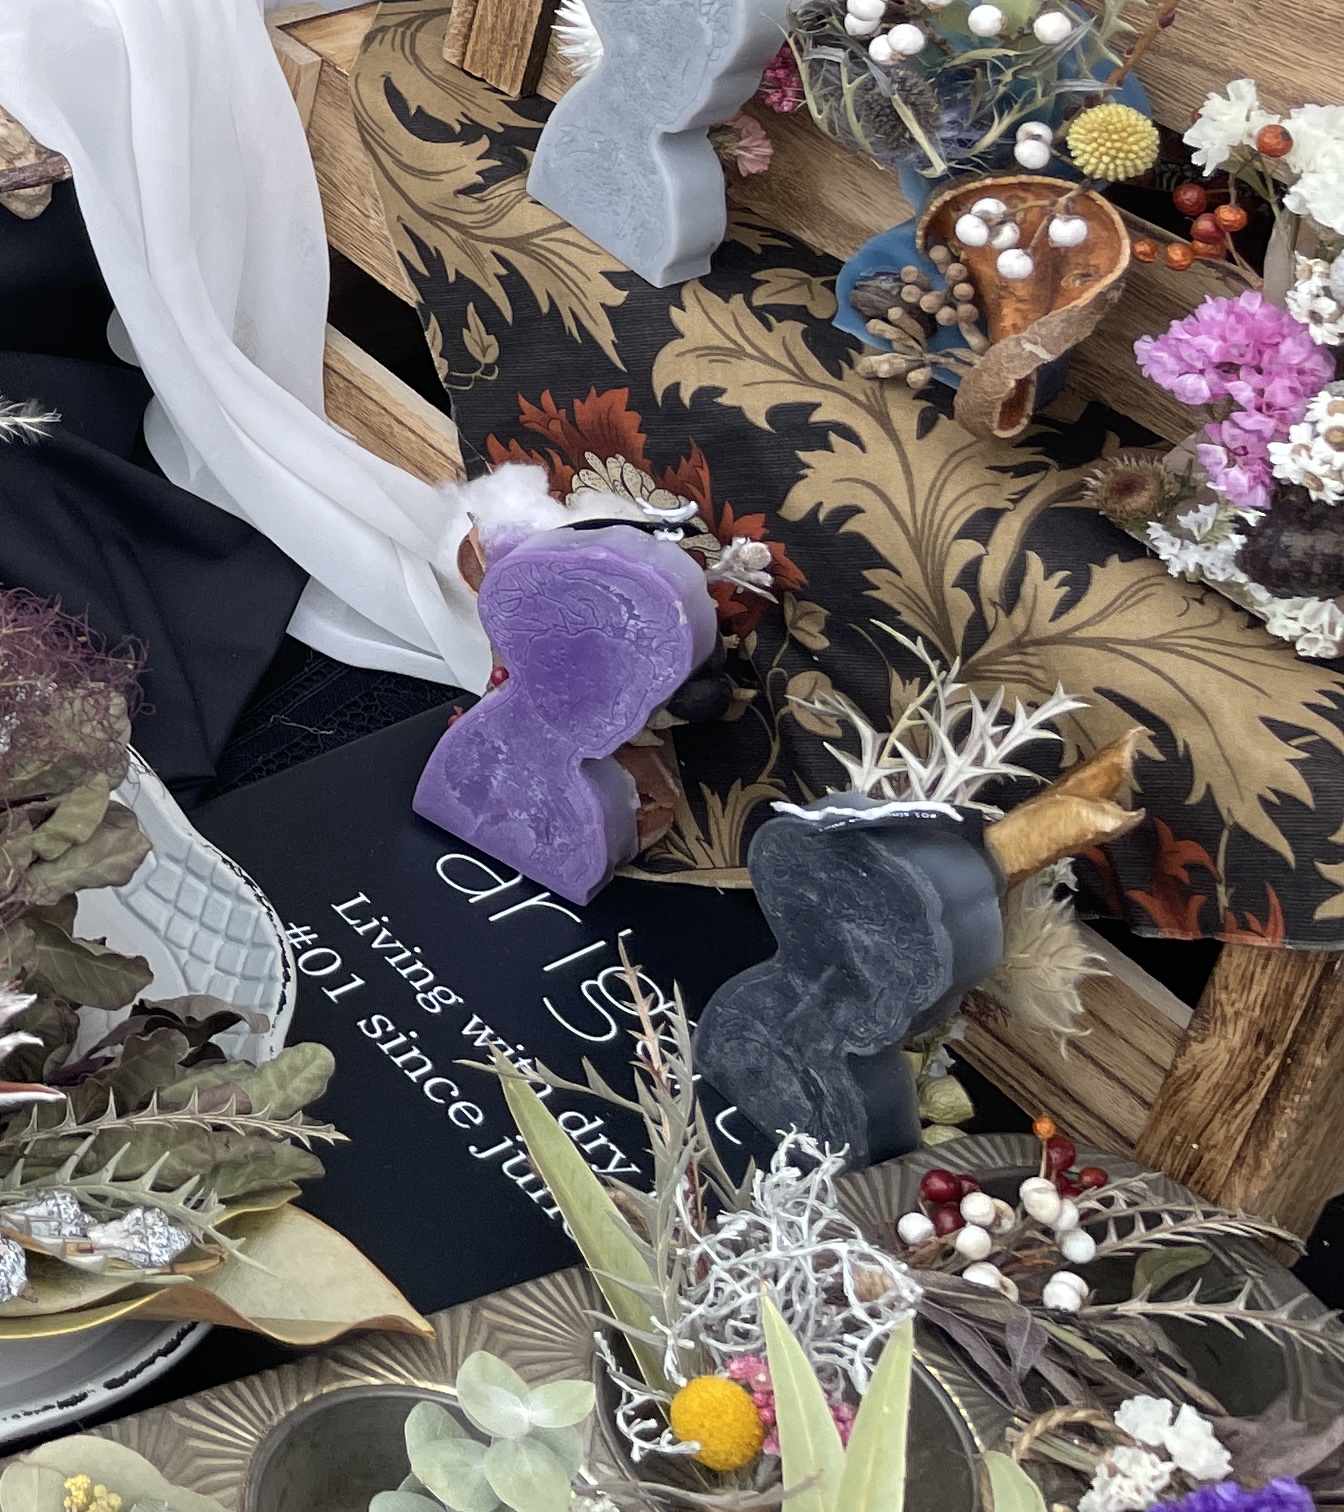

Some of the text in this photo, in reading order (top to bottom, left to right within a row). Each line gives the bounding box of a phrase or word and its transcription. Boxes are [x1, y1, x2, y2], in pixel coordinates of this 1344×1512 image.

[284, 921, 368, 1005] #01
[355, 1012, 485, 1131] since
[330, 891, 464, 1015] Living
[557, 1110, 642, 1175] dry
